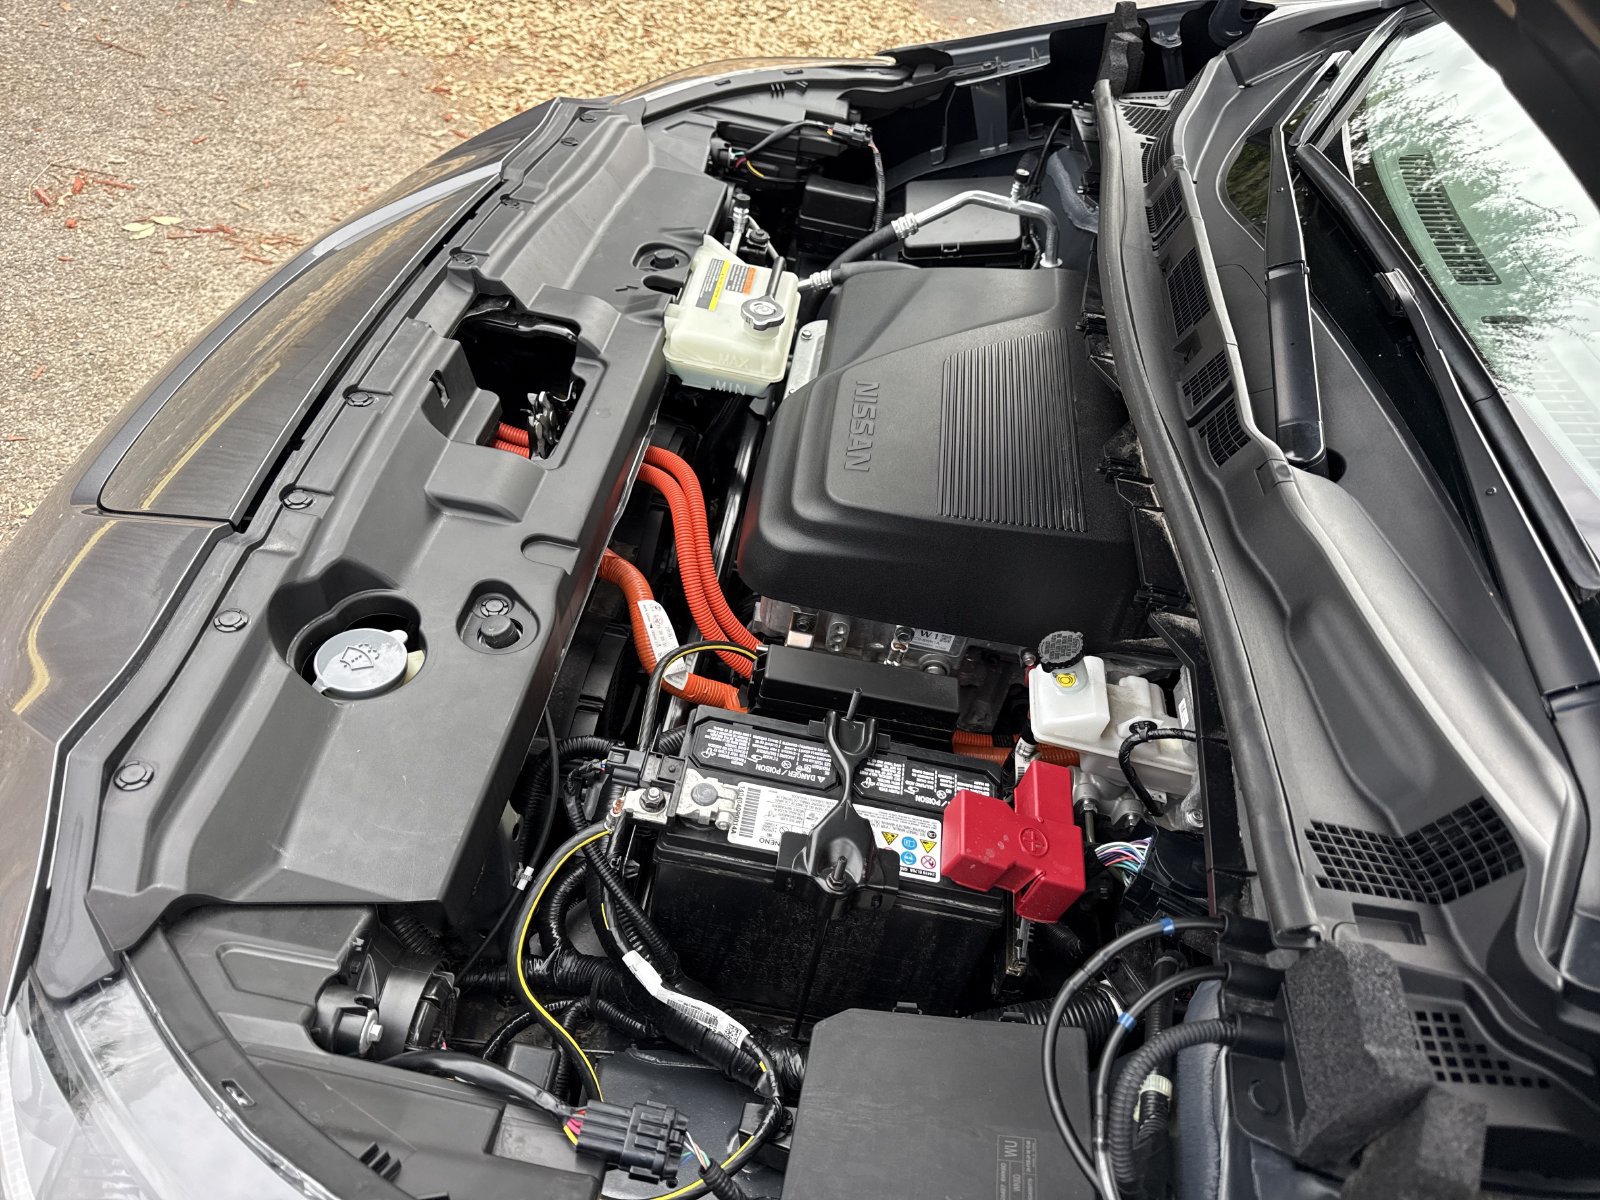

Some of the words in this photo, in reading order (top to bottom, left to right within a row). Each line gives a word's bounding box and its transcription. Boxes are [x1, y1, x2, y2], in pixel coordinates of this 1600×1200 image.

[718, 352, 750, 369] MAX
[715, 380, 746, 395] MIN
[843, 380, 880, 473] NISSAN
[755, 763, 781, 775] POISON
[788, 770, 816, 781] DANGER
[915, 795, 941, 806] POISON
